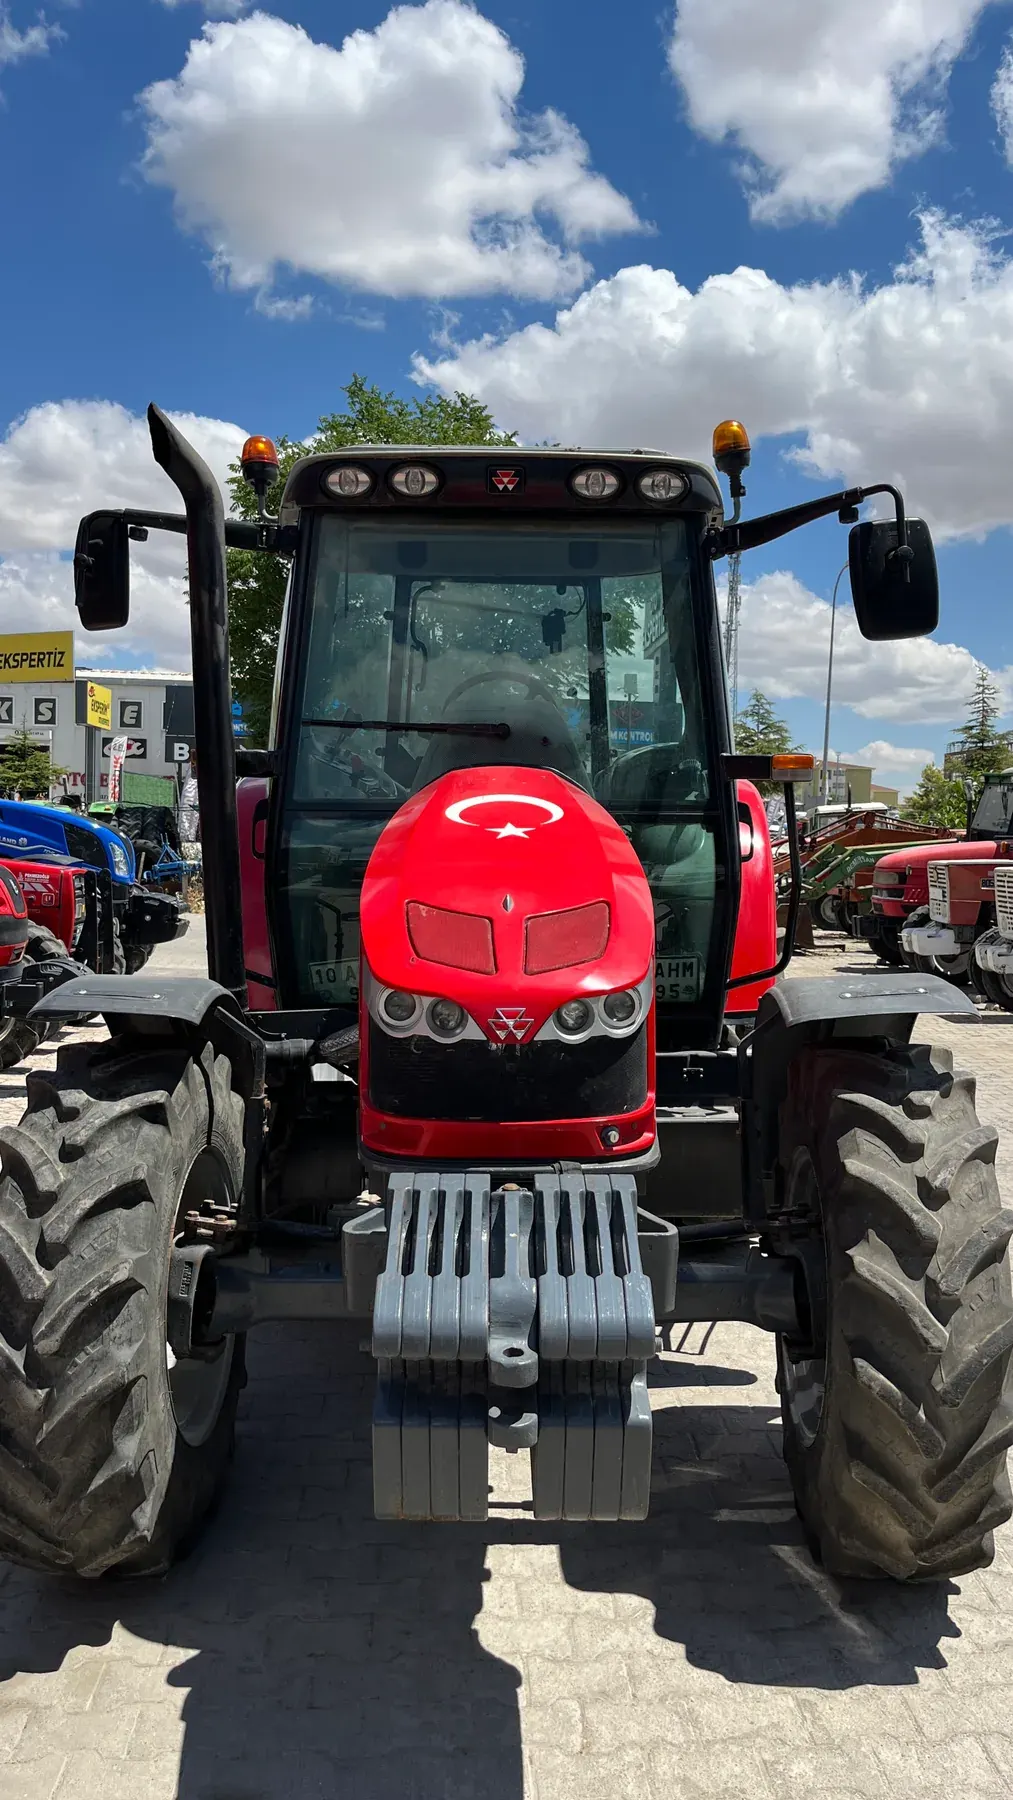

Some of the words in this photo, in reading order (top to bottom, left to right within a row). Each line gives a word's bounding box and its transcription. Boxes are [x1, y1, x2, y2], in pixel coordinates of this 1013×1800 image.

[37, 702, 54, 721] S
[123, 705, 139, 724] E
[315, 968, 337, 985] 10
[655, 961, 694, 979] AHM
